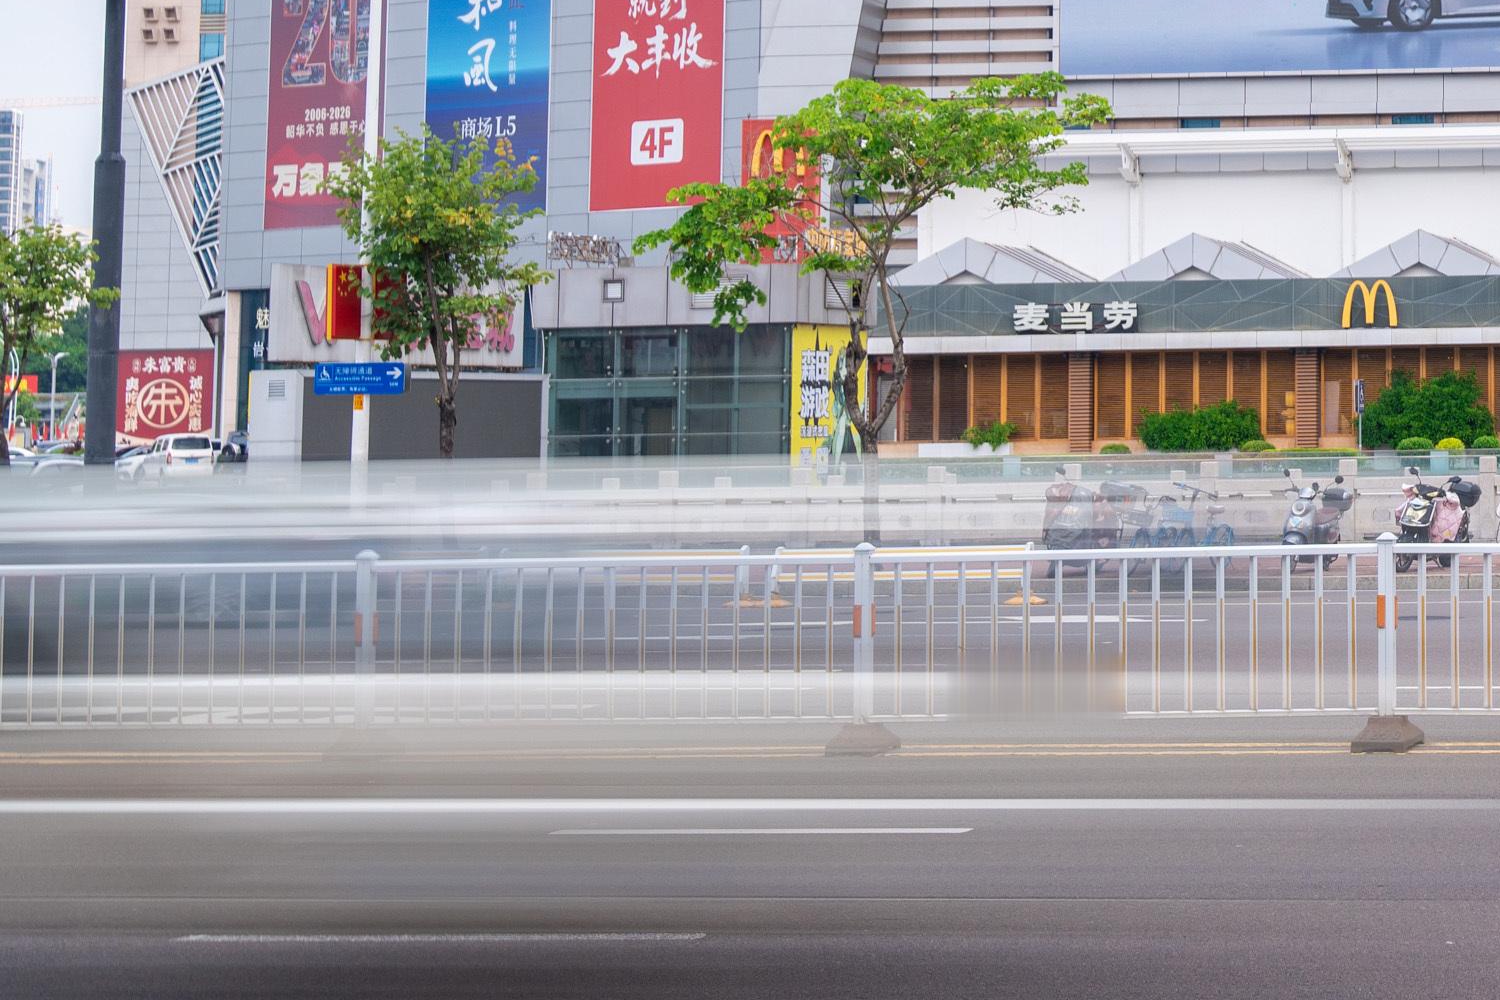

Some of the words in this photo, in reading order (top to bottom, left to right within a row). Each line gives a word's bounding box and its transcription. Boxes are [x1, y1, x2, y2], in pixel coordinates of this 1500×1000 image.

[285, 122, 325, 139] 韶华不负
[639, 125, 673, 160] 4F
[1012, 300, 1139, 332] 麦当劳
[800, 385, 830, 418] 游戏
